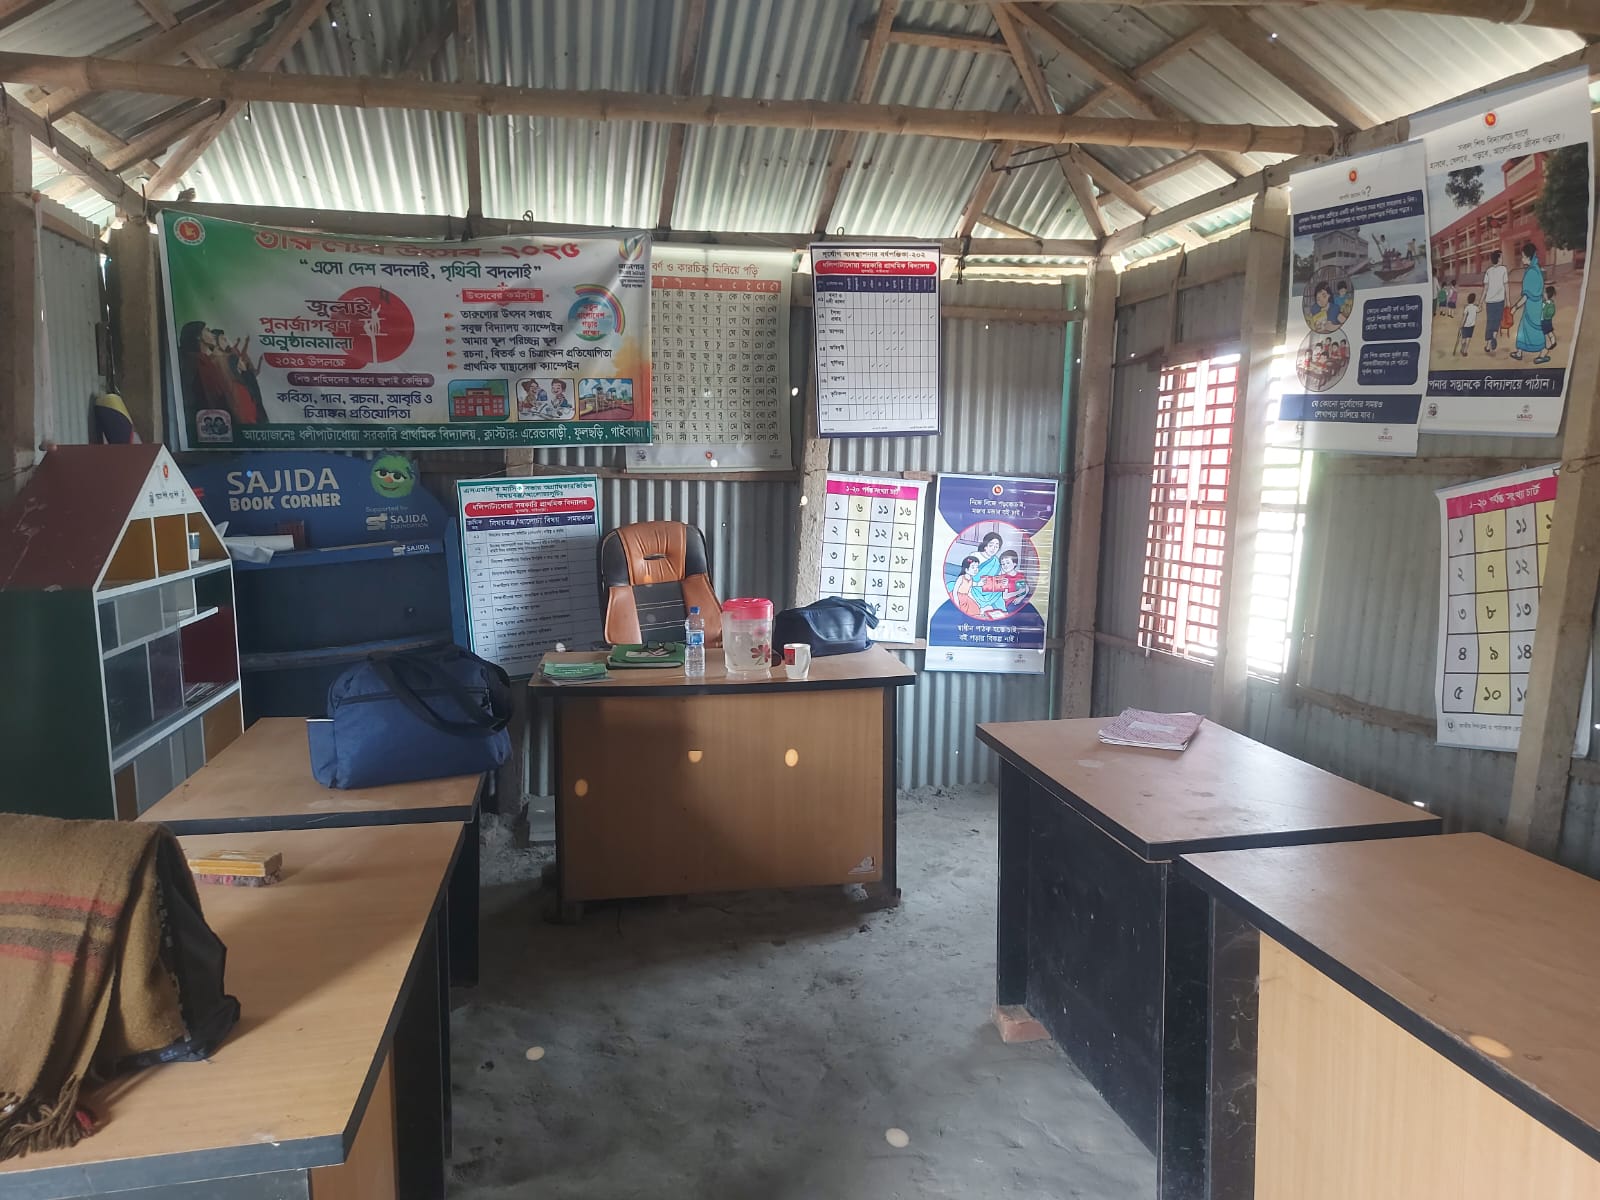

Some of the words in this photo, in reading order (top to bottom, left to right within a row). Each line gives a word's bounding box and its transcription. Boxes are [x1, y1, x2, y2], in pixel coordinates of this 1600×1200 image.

[349, 262, 375, 276] দেশ
[381, 262, 435, 279] বদলাই,
[440, 260, 481, 282] পৃথিবী
[713, 263, 740, 274] মিলিয়ে
[743, 264, 759, 278] পড়ি
[304, 297, 370, 318] জুলাই
[501, 308, 526, 319] উৎসব
[528, 310, 553, 320] সপ্তাহ
[259, 316, 350, 334] পুনর্জাগরণ
[460, 324, 482, 334] সবুজ
[485, 321, 519, 333] বিদ্যালয়
[523, 321, 564, 333] ক্যাম্পেইন
[258, 332, 353, 352] অনুষ্ঠানমালা
[462, 337, 487, 346] আমার
[491, 347, 516, 358] বিতর্ক
[519, 350, 526, 358] ও
[566, 346, 612, 358] প্রতিযোগিতা
[275, 357, 305, 367] ২০২৫
[307, 355, 347, 368] উপলক্ষে
[464, 360, 497, 371] প্রাথমিক
[540, 360, 580, 371] ক্যাম্পেইন
[1428, 379, 1448, 391] পনার
[1450, 379, 1481, 392] সন্তানকে
[1484, 375, 1523, 391] বিদ্যালয়ে
[276, 388, 318, 404] কবিতা,
[321, 392, 346, 405] গান,
[349, 392, 383, 405] রচনা,
[387, 390, 422, 407] আবৃত্তি
[424, 393, 433, 403] ও
[349, 405, 411, 419] প্রতিযোগিতা
[363, 426, 397, 441] সরকারি
[400, 426, 436, 441] প্রাথমিক
[226, 467, 340, 495] SAJIDA
[1505, 490, 1525, 502] সংখ্যা
[1526, 483, 1541, 497] চার্ট
[229, 495, 275, 512] BOOK
[280, 492, 342, 509] CORNER
[834, 501, 840, 511] ১
[856, 503, 863, 512] ৬
[878, 505, 889, 514] ১১
[899, 506, 912, 516] ১৬
[390, 514, 428, 524] SAJIDA
[832, 526, 839, 536] ২
[854, 528, 860, 537] ৭
[874, 528, 888, 539] ১২
[898, 531, 909, 541] ১৭
[1459, 529, 1464, 543] ১
[1486, 524, 1494, 538] ৬
[1515, 518, 1527, 534] ১১
[406, 544, 430, 552] SAJIDA
[830, 551, 838, 560] ৩
[852, 553, 859, 561] ৮
[872, 554, 886, 563] ১৩
[895, 555, 908, 564] ১৮
[1457, 567, 1465, 582] ২
[1487, 564, 1495, 579] ৭
[1515, 559, 1530, 575] ১২
[828, 575, 835, 585] ৪
[850, 577, 857, 587] ৯
[871, 578, 883, 588] ১৪
[893, 579, 906, 589] ১৯
[891, 603, 904, 613] ২০
[1457, 608, 1467, 620] ৩
[1486, 605, 1497, 620] ৮
[1516, 603, 1532, 618] ১৩
[1458, 646, 1467, 661] ৪
[1489, 646, 1499, 661] ৯
[1517, 644, 1533, 660] ১৪
[1453, 686, 1464, 700] ৫
[1483, 686, 1502, 701] ১০
